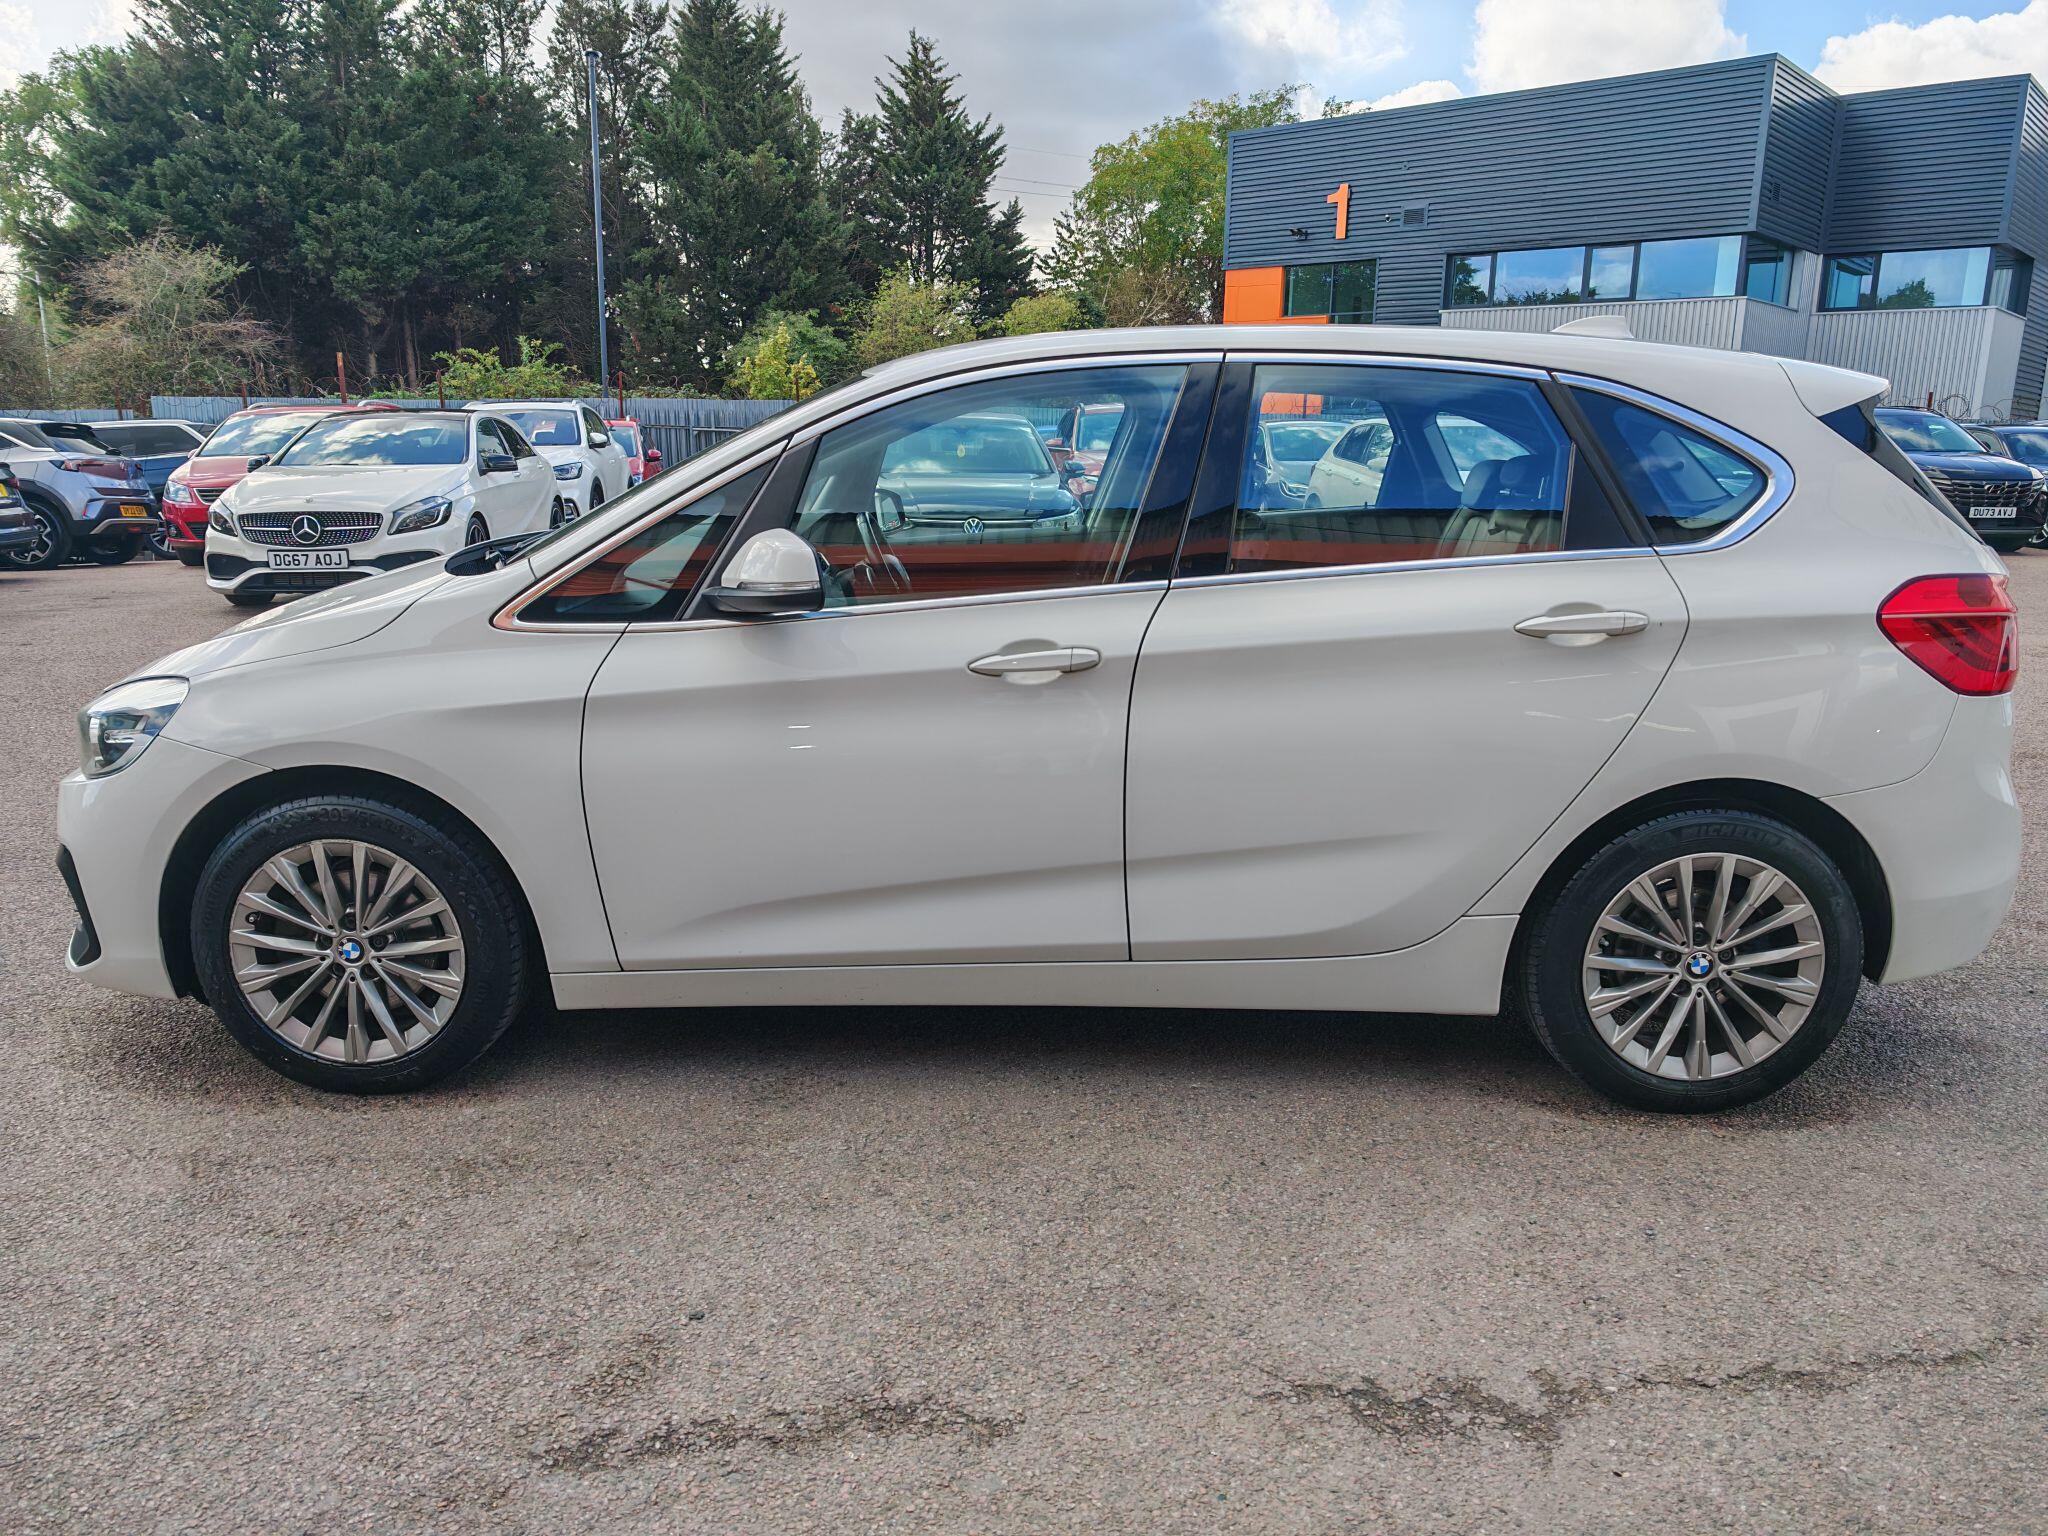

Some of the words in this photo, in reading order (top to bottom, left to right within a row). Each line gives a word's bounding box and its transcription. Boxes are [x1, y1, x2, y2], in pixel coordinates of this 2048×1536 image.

[1326, 183, 1349, 240] 1
[1973, 508, 1995, 517] DU73
[1996, 508, 2013, 516] AVJ
[273, 553, 309, 566] DG67
[315, 553, 342, 566] AOJ
